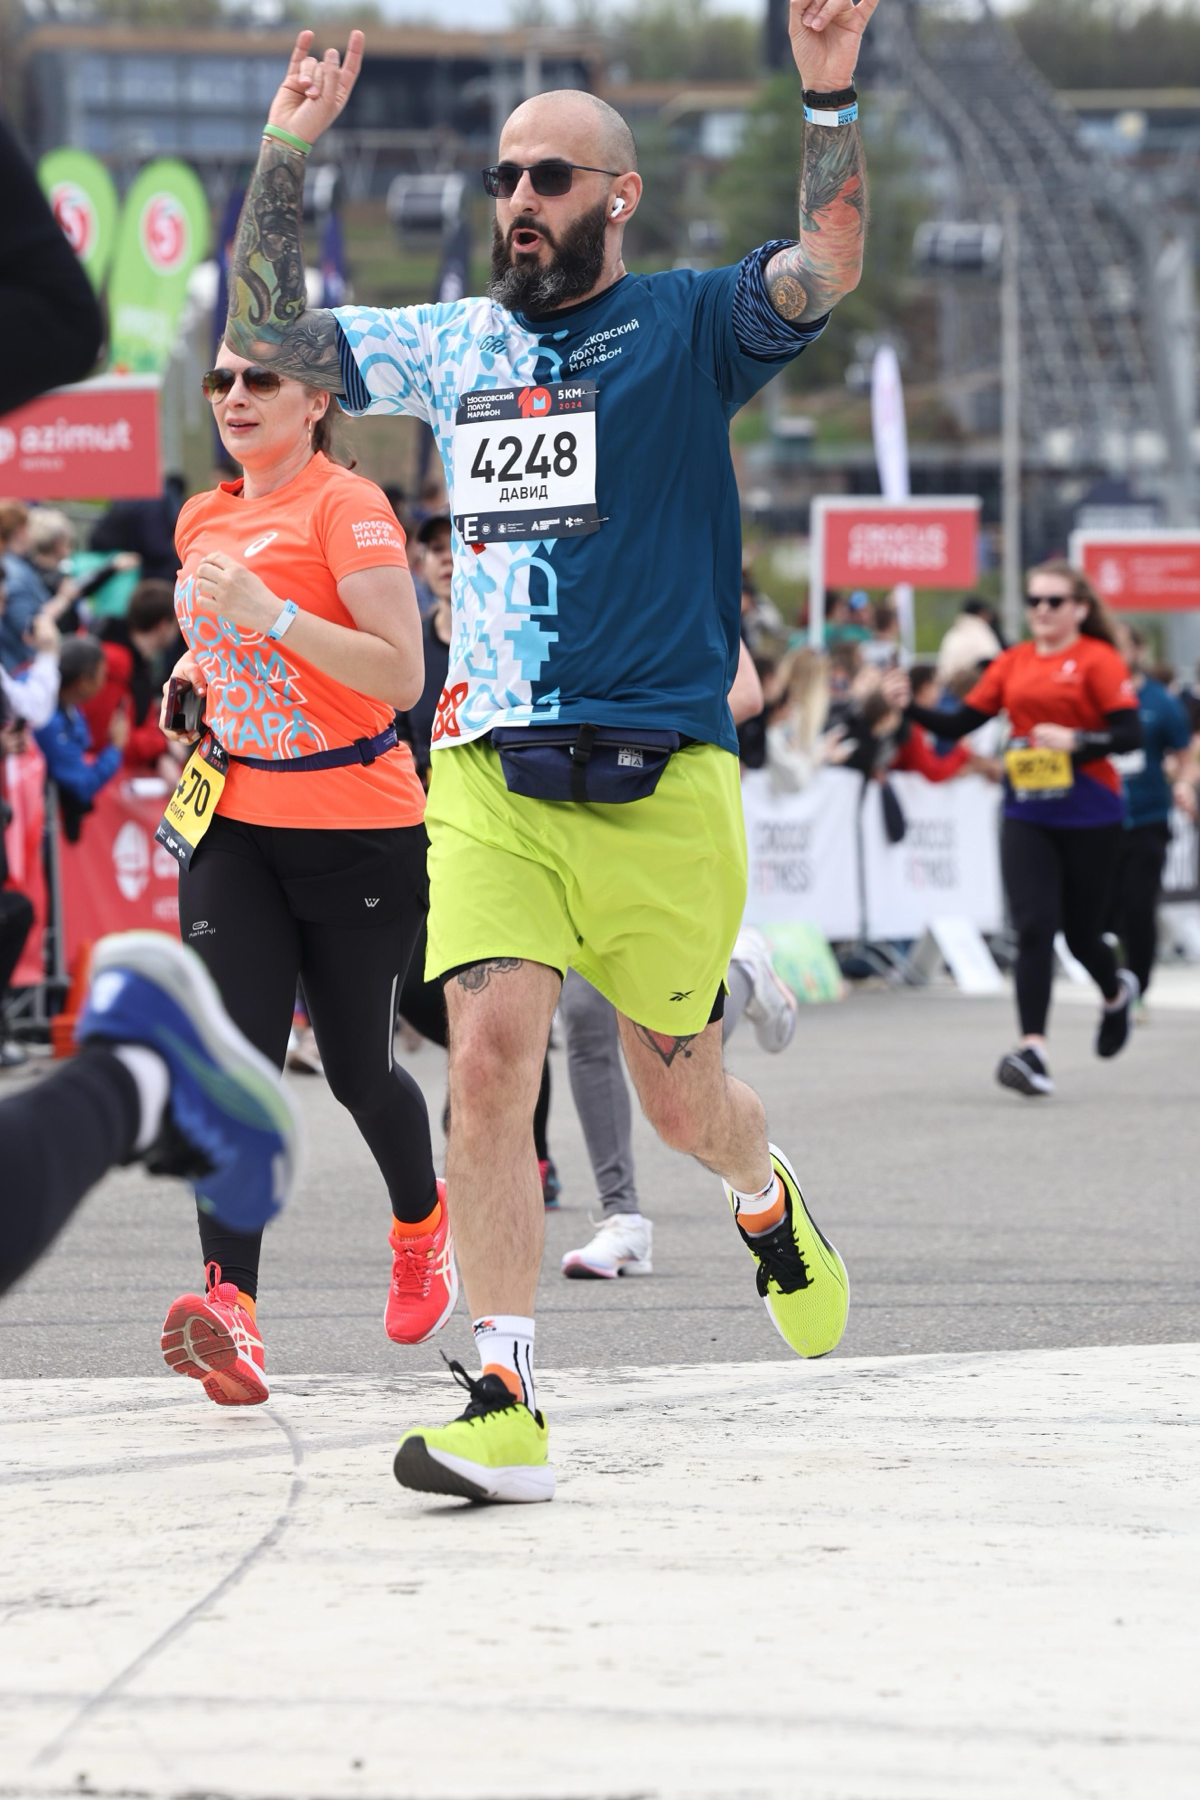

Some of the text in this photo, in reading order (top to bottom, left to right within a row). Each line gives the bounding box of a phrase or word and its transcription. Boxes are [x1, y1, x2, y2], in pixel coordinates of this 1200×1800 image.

[569, 347, 622, 372] МАРАФОН
[467, 392, 514, 404] МОСКОВСКИЙ
[558, 401, 582, 410] 2024
[467, 409, 500, 418] МАРАФОН
[19, 416, 132, 453] azimut
[470, 431, 578, 483] 4248
[499, 485, 548, 503] ДАВИД
[354, 529, 381, 541] HALF
[211, 710, 317, 750] МАРА
